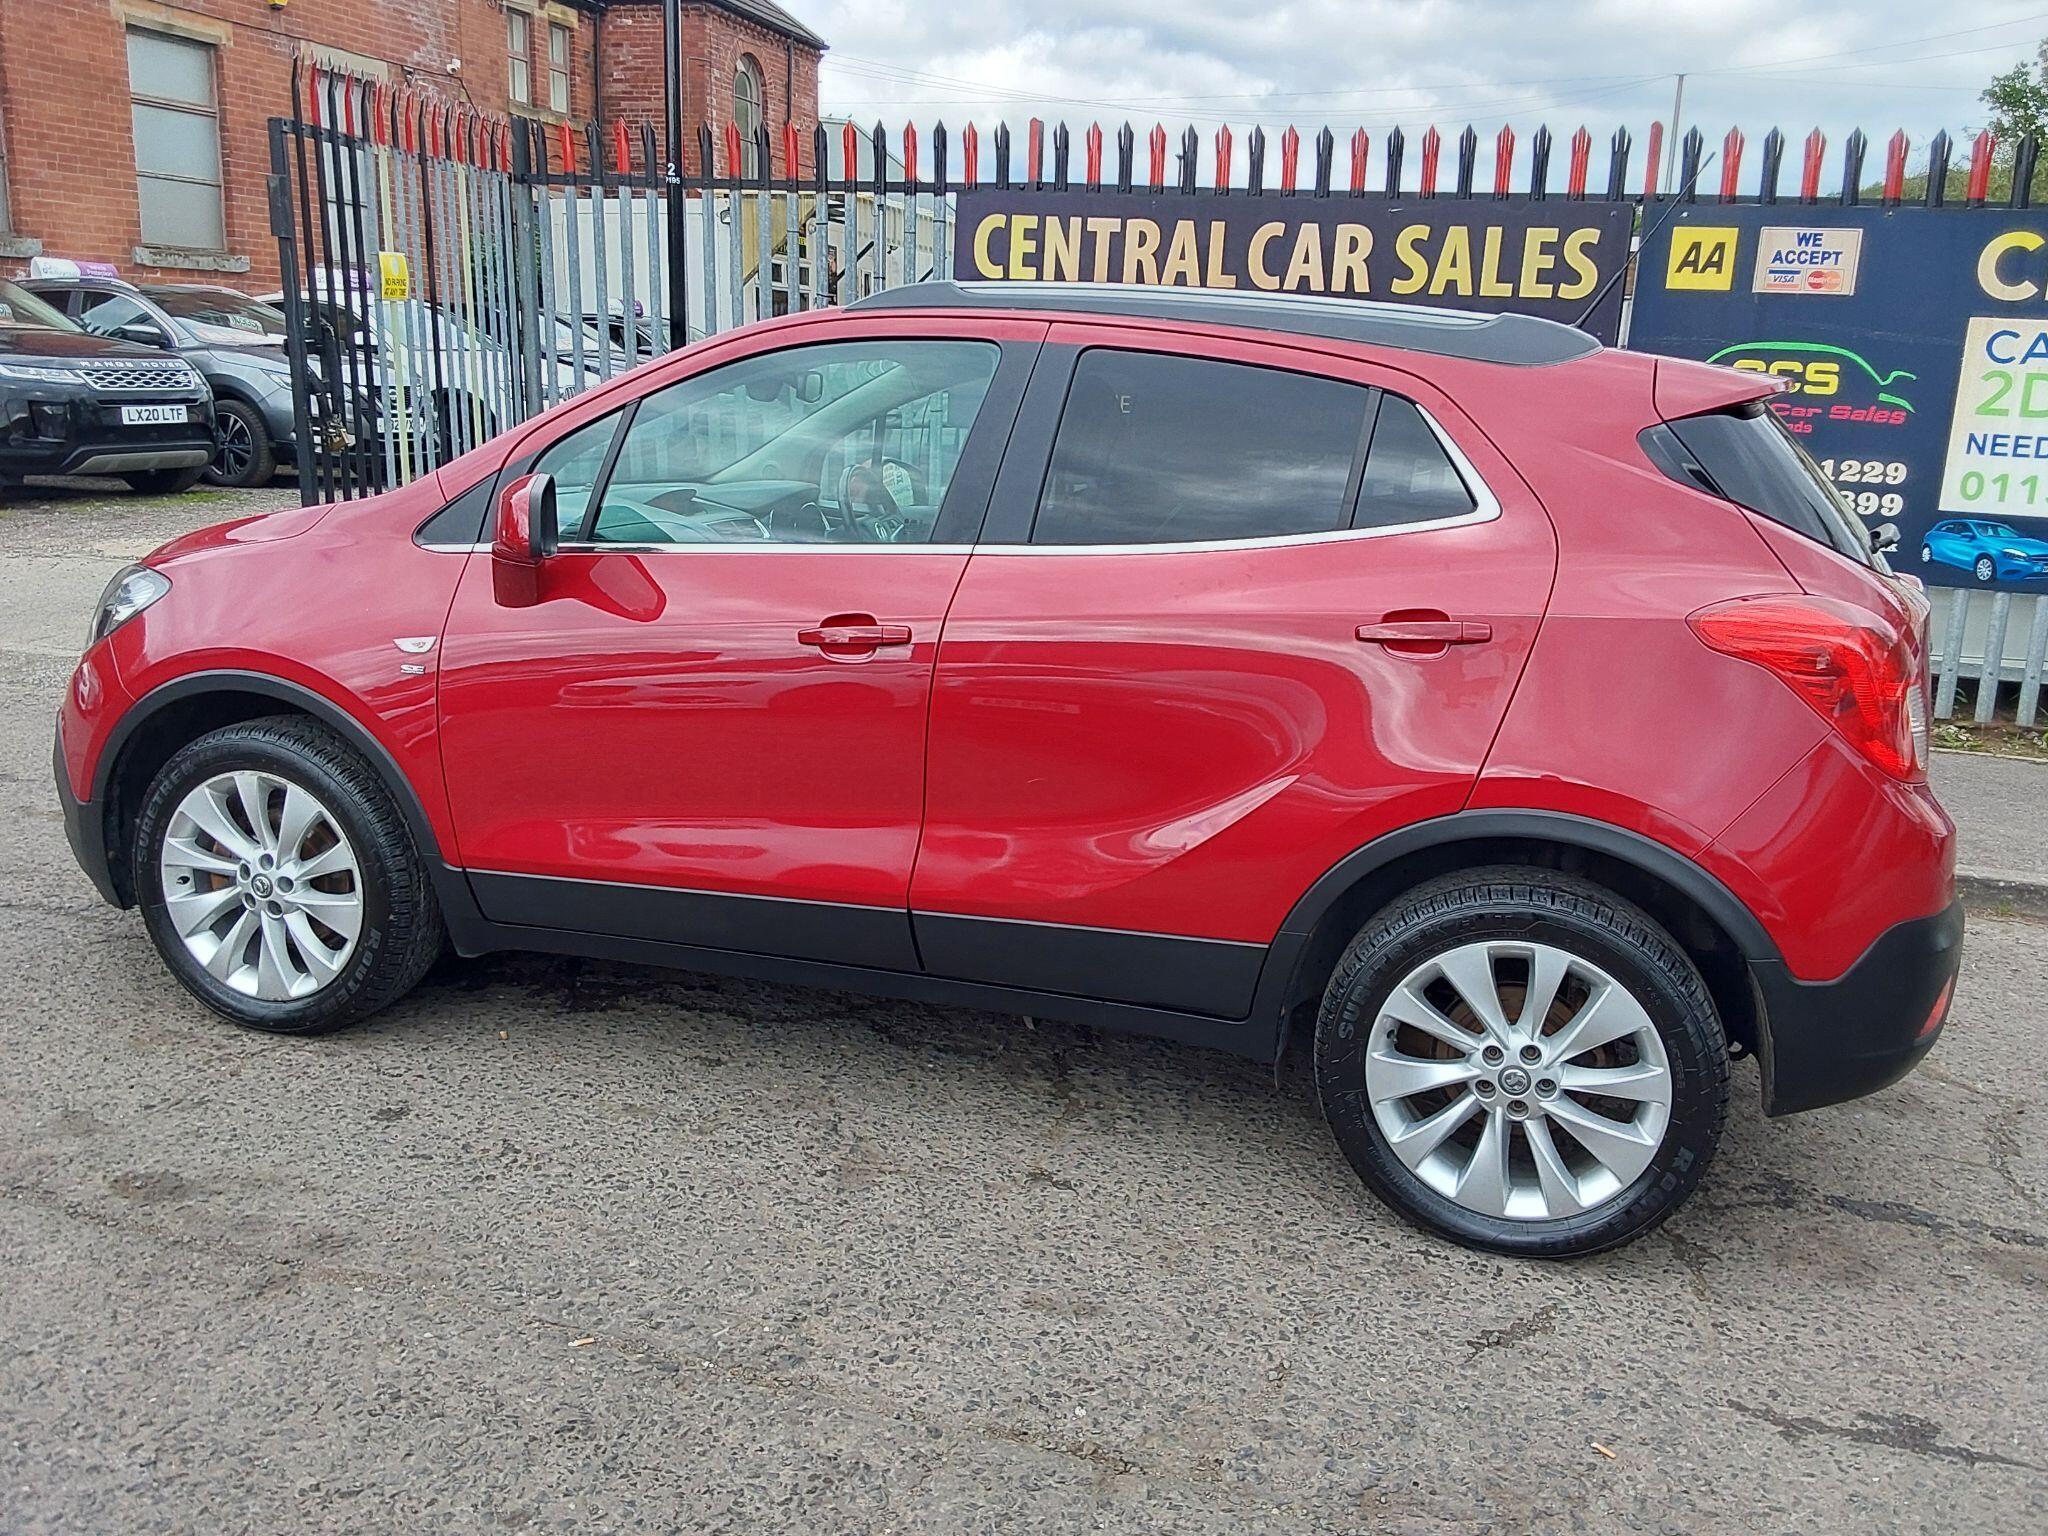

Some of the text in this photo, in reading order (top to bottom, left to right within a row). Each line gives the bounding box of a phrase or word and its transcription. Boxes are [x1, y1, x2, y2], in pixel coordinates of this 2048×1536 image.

[1796, 232, 1823, 247] WE
[973, 213, 1601, 300] CENTRAL CAR SALES
[1674, 241, 1726, 274] AA
[1771, 249, 1843, 265] ACCEPT
[1977, 231, 2048, 301] C
[1772, 274, 1795, 283] VISA
[127, 408, 183, 422] LX20 LTF
[1828, 406, 1907, 425] Sales
[1959, 470, 2048, 505] 011
